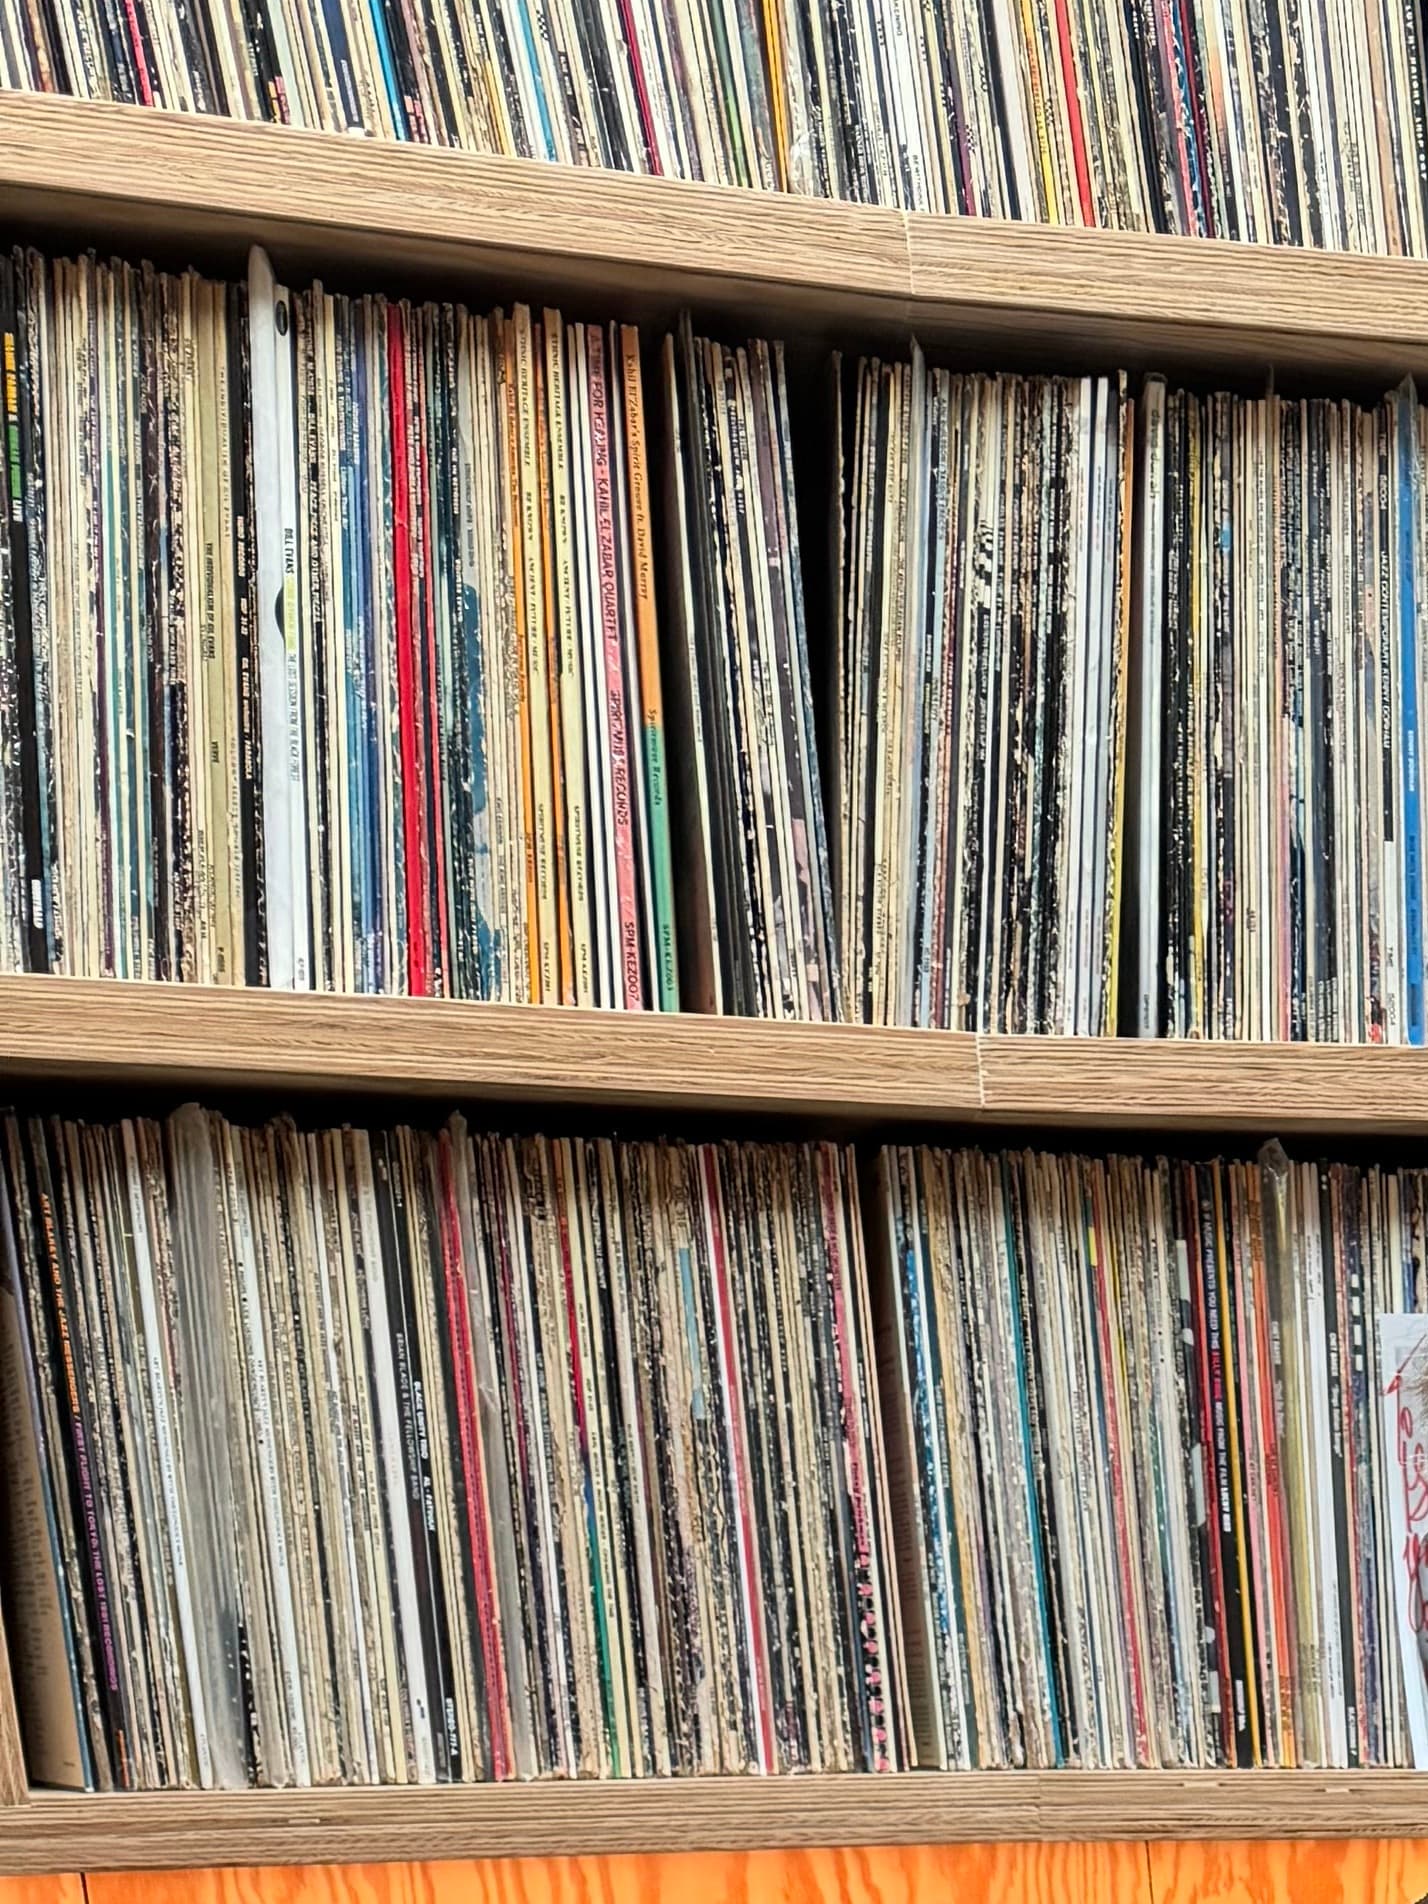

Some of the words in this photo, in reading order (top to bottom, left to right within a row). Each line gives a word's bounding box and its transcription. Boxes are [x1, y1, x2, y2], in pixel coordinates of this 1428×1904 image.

[626, 355, 638, 384] Kahil
[631, 441, 642, 469] Spirit
[592, 383, 605, 409] FOR
[603, 583, 618, 642] QUARTET
[635, 528, 647, 560] David
[380, 551, 389, 578] JAZZ
[380, 580, 390, 665] CONTEMPORARY
[381, 668, 390, 702] KENNY
[613, 768, 628, 826] RECORDS
[651, 766, 662, 806] Records
[624, 923, 640, 1002] SPM-KEZ007
[41, 1193, 52, 1213] ART
[44, 1217, 58, 1259] BLAKEY
[1204, 1222, 1213, 1247] MUSIC
[51, 1262, 62, 1284] AND
[1205, 1249, 1216, 1289] PRESENTS
[55, 1288, 65, 1307] THE
[1208, 1292, 1217, 1307] YOU
[58, 1310, 70, 1337] JAZZ
[1209, 1310, 1218, 1329] NEED
[396, 1334, 406, 1359] BRIAN
[1211, 1332, 1220, 1349] THIS
[1329, 1333, 1338, 1351] CHET
[62, 1340, 80, 1413] MESSENGERS
[398, 1363, 409, 1390] BLADE
[414, 1381, 424, 1409] BLACK
[402, 1402, 412, 1418] THE
[1215, 1402, 1225, 1425] MUSIC
[74, 1422, 86, 1453] FIRST
[417, 1412, 426, 1437] UNITY
[404, 1421, 417, 1472] FELLOWSHIP
[419, 1440, 428, 1458] TRIO
[1217, 1428, 1226, 1449] FROM
[1218, 1452, 1227, 1466] THE
[78, 1455, 91, 1491] FLIGHT
[1219, 1468, 1229, 1486] FILM
[409, 1476, 420, 1498] BAND
[84, 1494, 94, 1508] TO
[91, 1551, 102, 1570] THE
[94, 1572, 106, 1598] LOST
[101, 1624, 118, 1690] RECORDINGS
